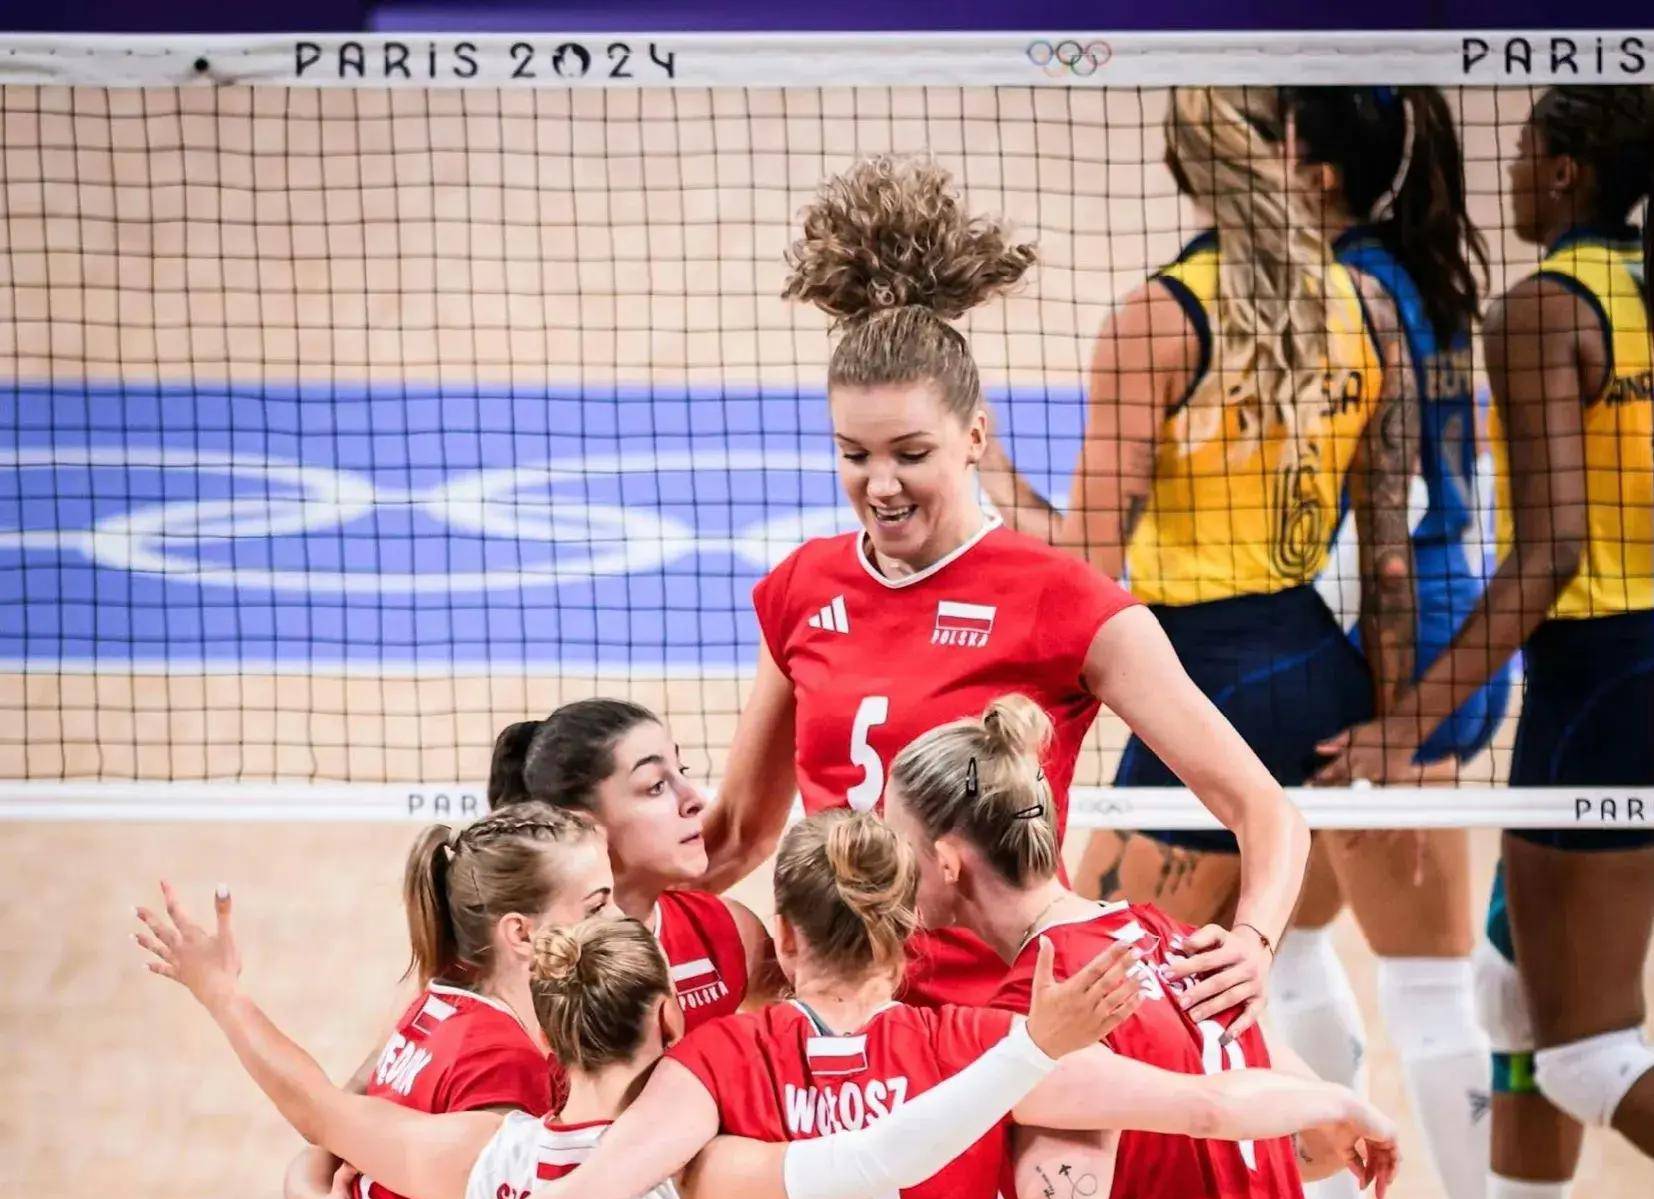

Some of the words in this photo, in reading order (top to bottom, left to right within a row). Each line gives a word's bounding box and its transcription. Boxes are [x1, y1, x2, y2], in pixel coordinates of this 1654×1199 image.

[930, 629, 988, 648] POLSKA
[847, 696, 889, 812] 5
[678, 981, 729, 1011] POLSKA
